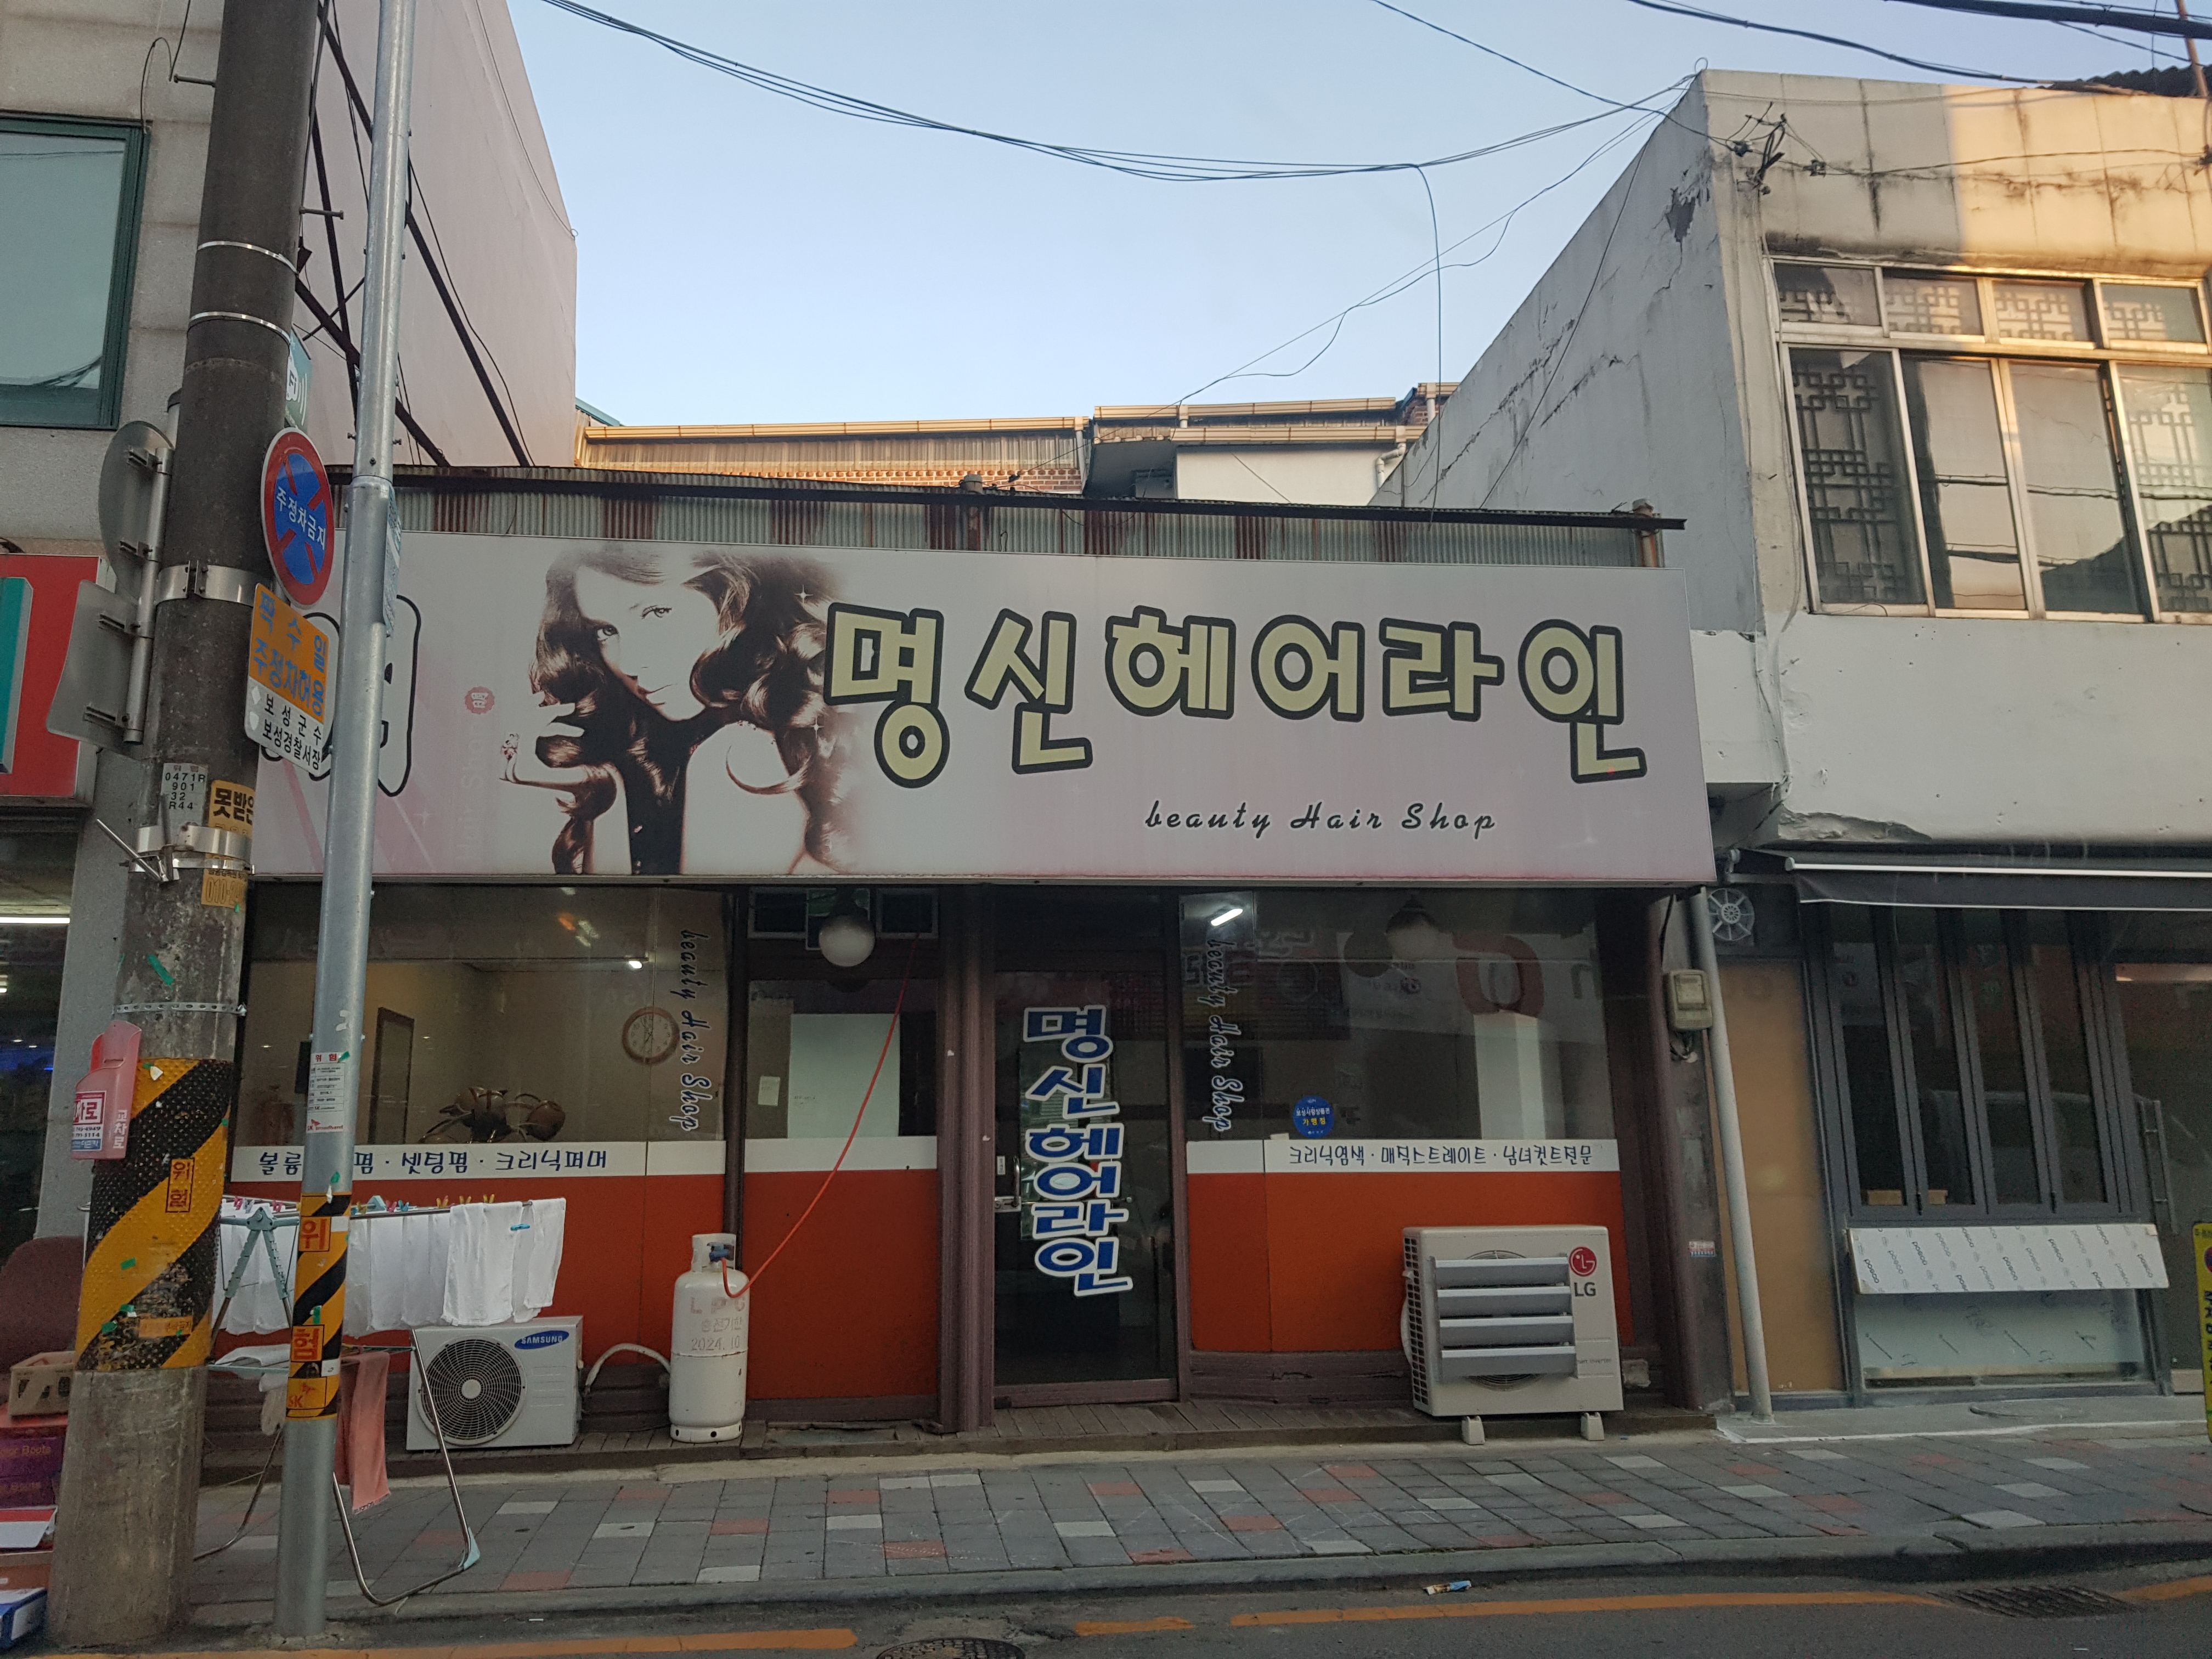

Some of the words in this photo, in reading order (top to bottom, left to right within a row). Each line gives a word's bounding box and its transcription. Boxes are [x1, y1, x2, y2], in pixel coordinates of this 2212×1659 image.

[276, 486, 326, 550] 주정차금지
[824, 602, 1647, 788] 명신헤어라인
[262, 719, 320, 770] 보성경찰서장
[1146, 800, 1271, 839] beauty
[1290, 802, 1382, 830] Hair
[1401, 802, 1495, 840] Shop
[670, 930, 710, 1000] beauty
[1198, 939, 1239, 1007] beauty
[681, 1010, 712, 1065] Hair
[1209, 1015, 1242, 1068] Hair
[669, 1073, 713, 1131] Shop
[1202, 1075, 1245, 1132] Shop
[113, 1109, 128, 1149] 교차로
[1023, 1005, 1133, 1297] 명신헤어라인
[1864, 1259, 1880, 1283] posco
[1912, 1241, 1927, 1266] posco
[2003, 1256, 2018, 1280] posco
[2048, 1239, 2064, 1263] posco
[1574, 1282, 1596, 1297] LG
[521, 1335, 563, 1345] SAMSUNG
